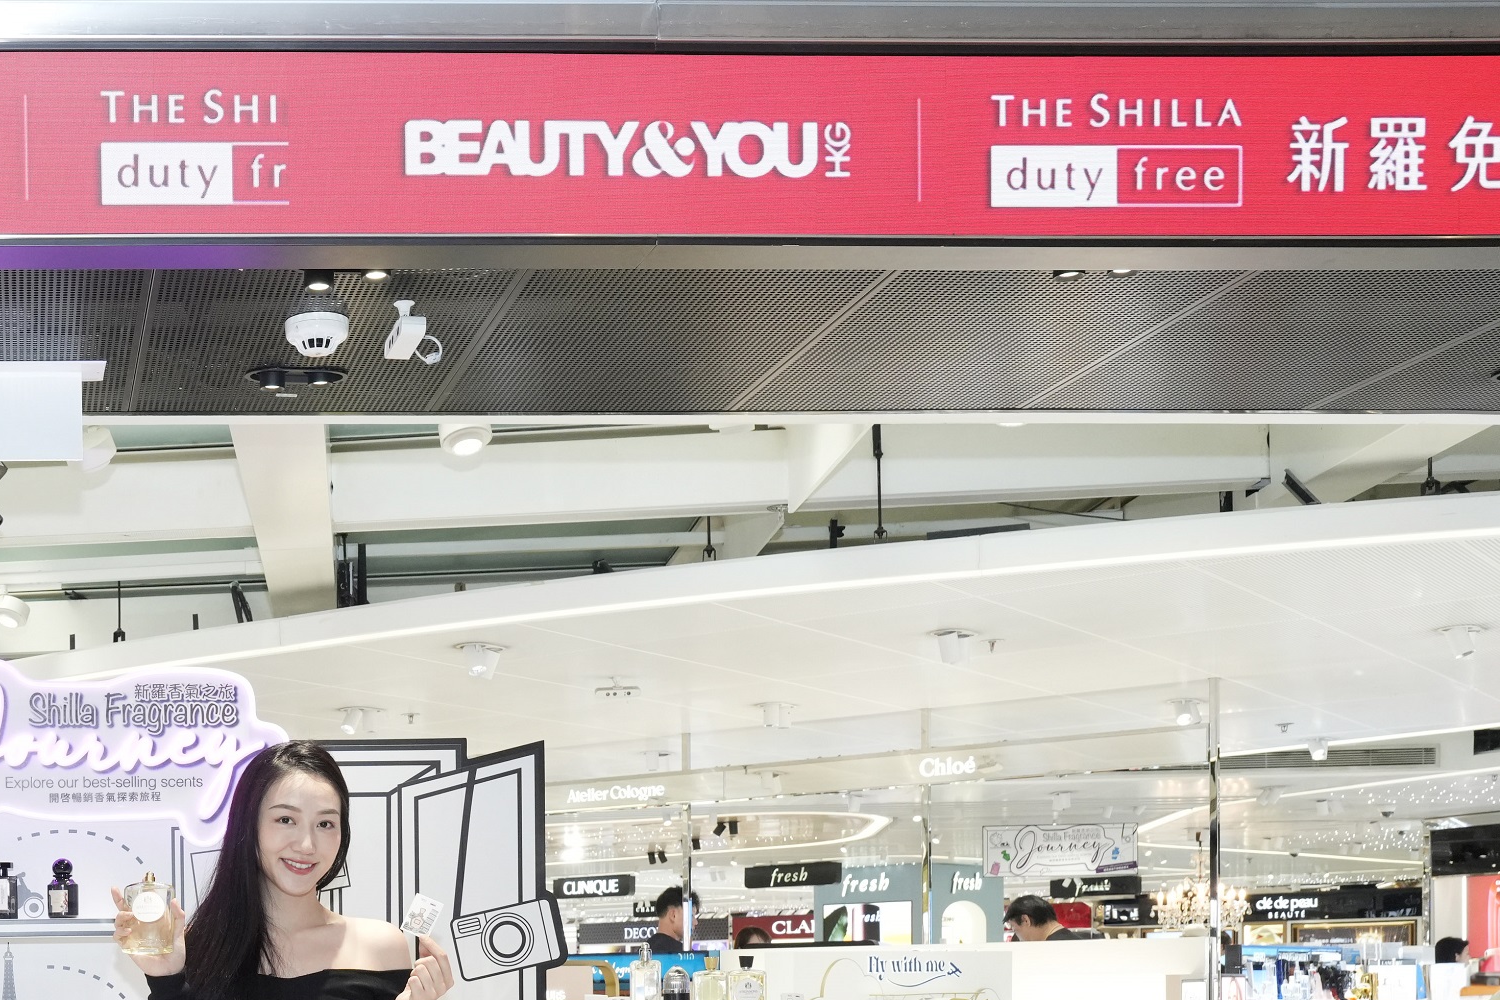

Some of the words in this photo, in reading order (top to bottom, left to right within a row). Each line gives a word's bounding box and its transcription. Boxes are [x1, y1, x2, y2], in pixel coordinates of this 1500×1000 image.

[101, 91, 185, 125] THE
[991, 95, 1072, 128] THE
[1089, 92, 1243, 128] SHILLA
[404, 118, 819, 179] BEAUTY&YOU
[823, 121, 851, 177] HKG
[117, 153, 219, 200] duty
[250, 152, 287, 189] fr
[1006, 158, 1104, 201] duty
[1133, 156, 1225, 192] free
[134, 683, 236, 701] 新羅香氣之旅
[28, 692, 98, 727] Shilla
[105, 692, 239, 735] Fragrance
[919, 756, 976, 778] Chloé
[5, 776, 53, 791] Explore
[57, 778, 79, 789] our
[82, 775, 157, 791] best-selling
[160, 776, 204, 788] scents
[567, 787, 609, 804] Atelier
[610, 784, 665, 801] Cologne
[1043, 831, 1062, 843] Shilla
[1064, 831, 1101, 843] Fragrance
[1016, 831, 1110, 870] Journey
[563, 879, 620, 895] CLINIQUE
[770, 867, 808, 887] fresh
[842, 872, 890, 898] fresh
[951, 871, 983, 894] fresh
[1255, 896, 1274, 910] clé
[1274, 896, 1289, 909] de
[1290, 897, 1318, 912] peau
[1267, 910, 1306, 919] BEAUTÉ
[869, 956, 887, 981] Fly
[891, 957, 922, 973] with
[926, 959, 945, 973] me
